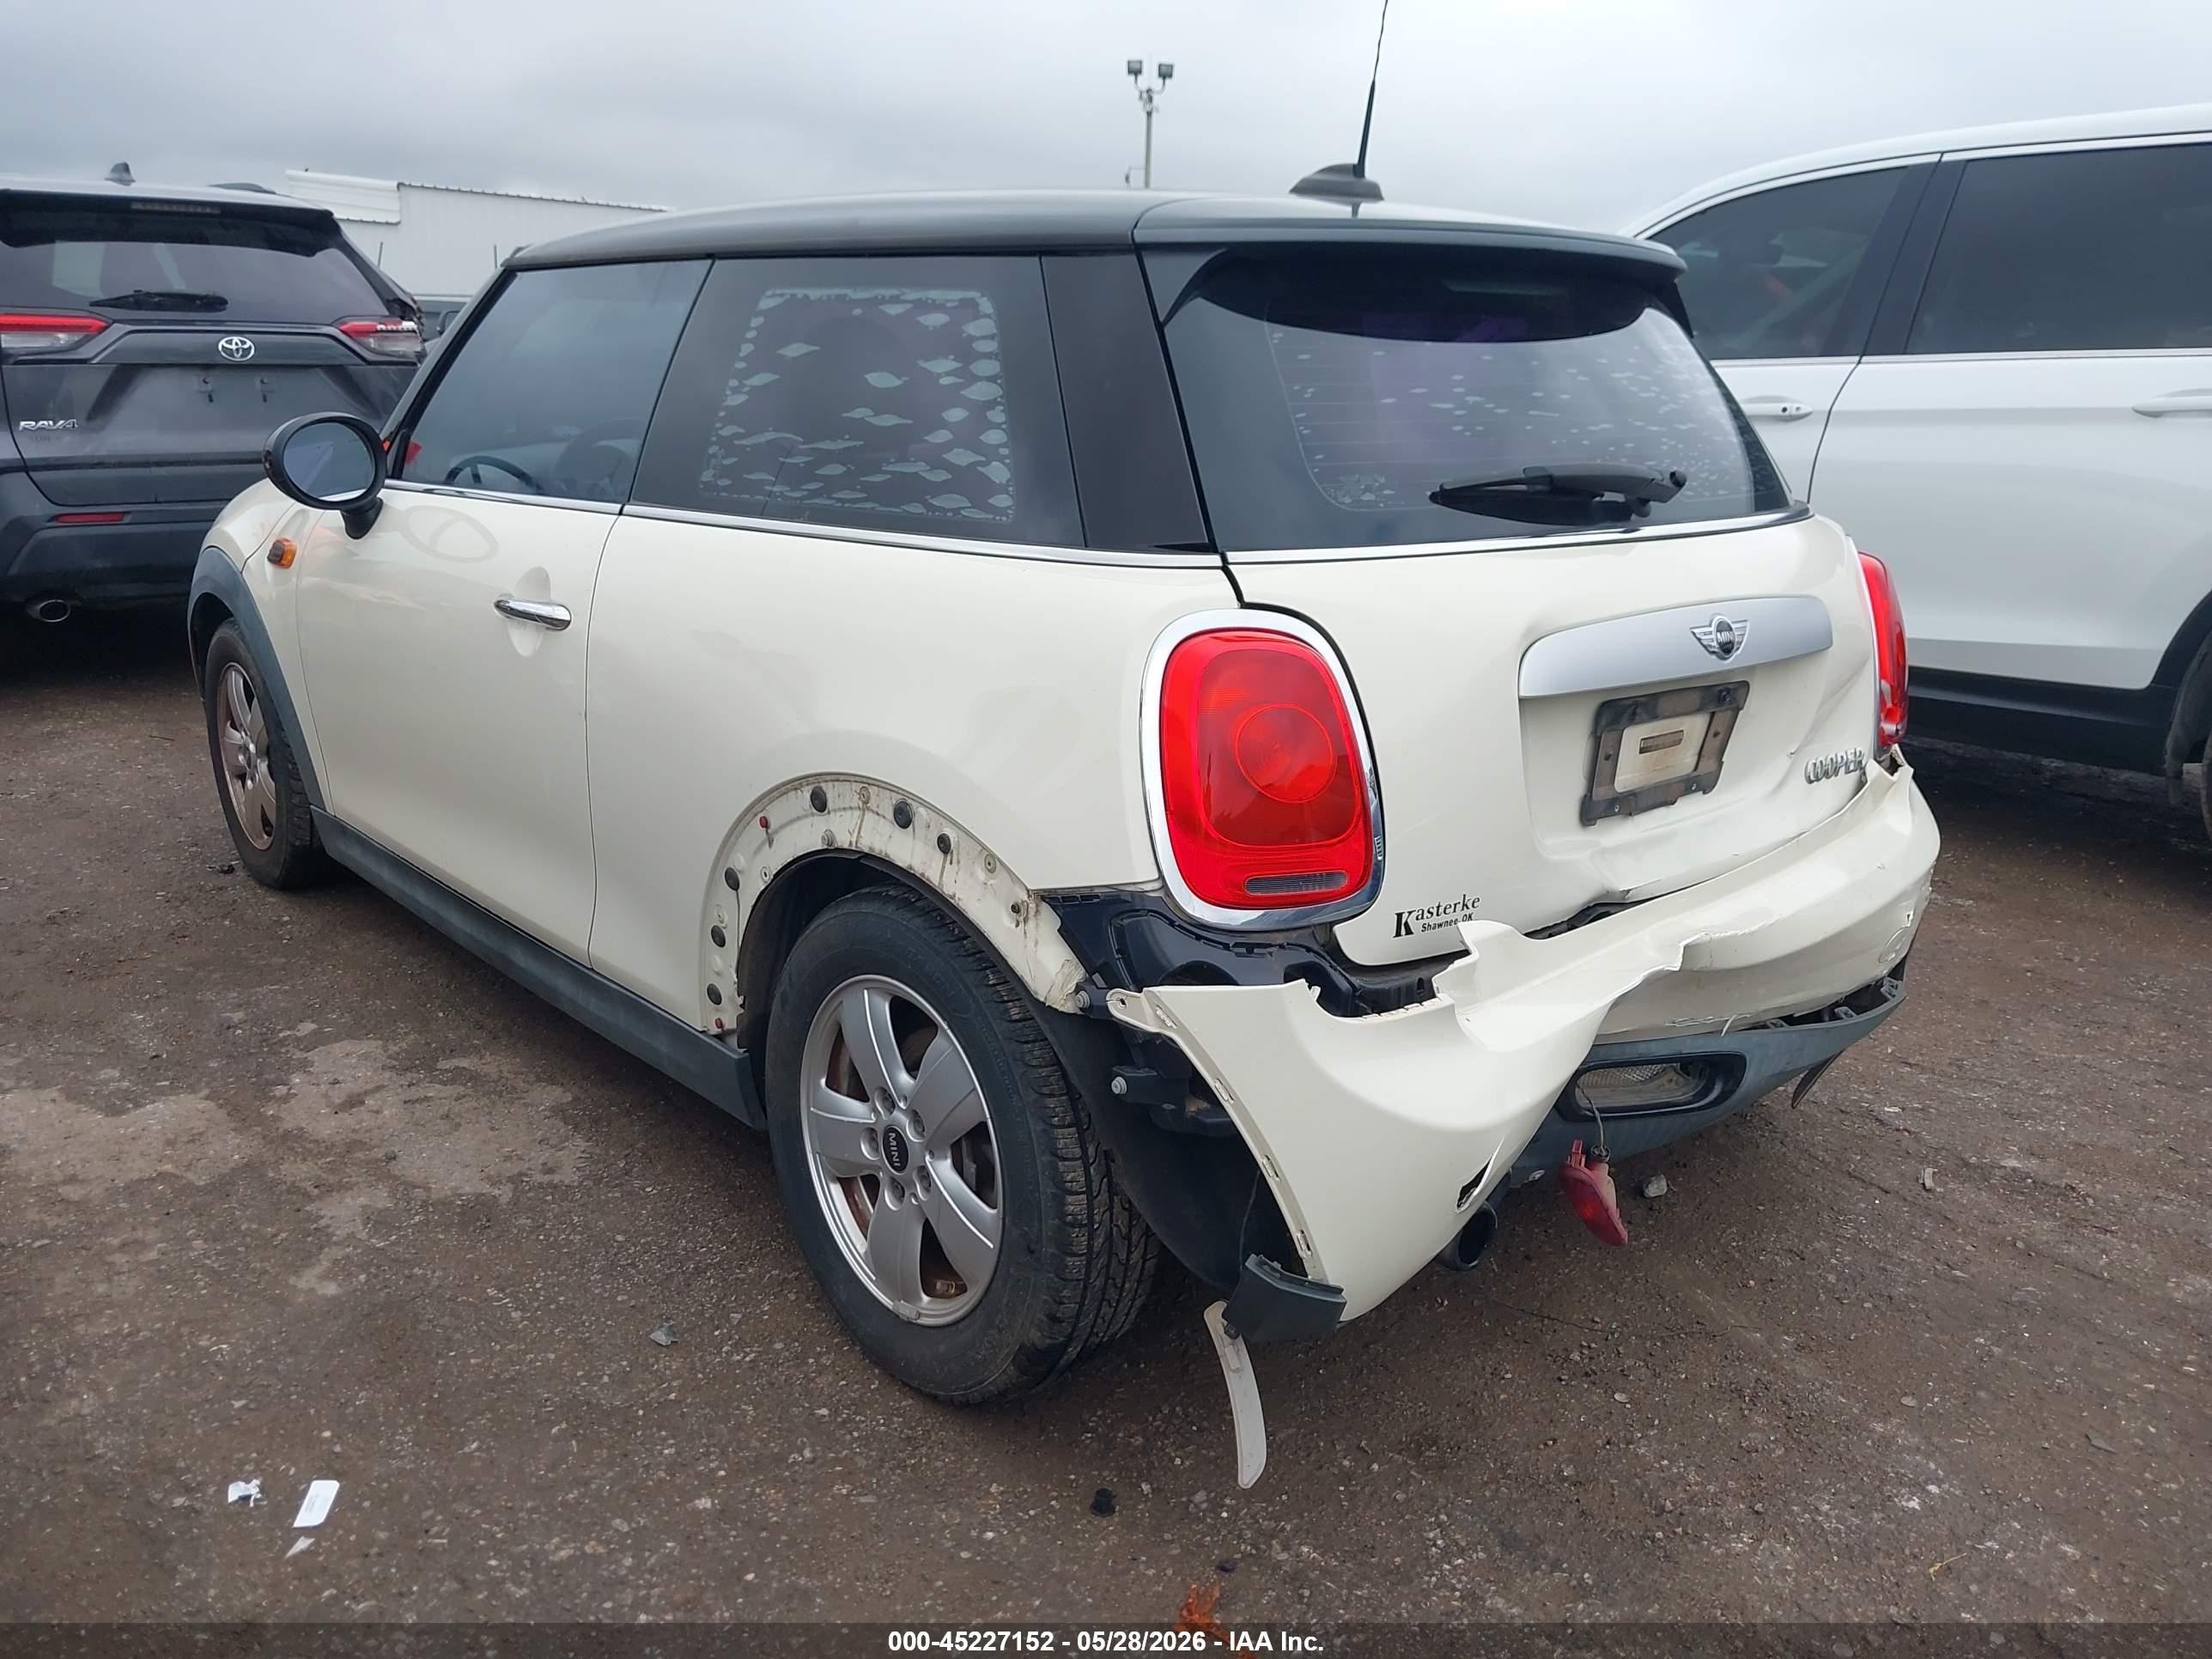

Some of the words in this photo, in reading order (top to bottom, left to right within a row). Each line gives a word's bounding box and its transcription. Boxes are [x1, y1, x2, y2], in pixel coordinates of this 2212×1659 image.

[19, 419, 78, 431] RAV4
[1804, 747, 1865, 784] COOPER
[1393, 894, 1480, 938] Kasterke
[1462, 912, 1474, 922] OK
[889, 1133, 901, 1166] MINI
